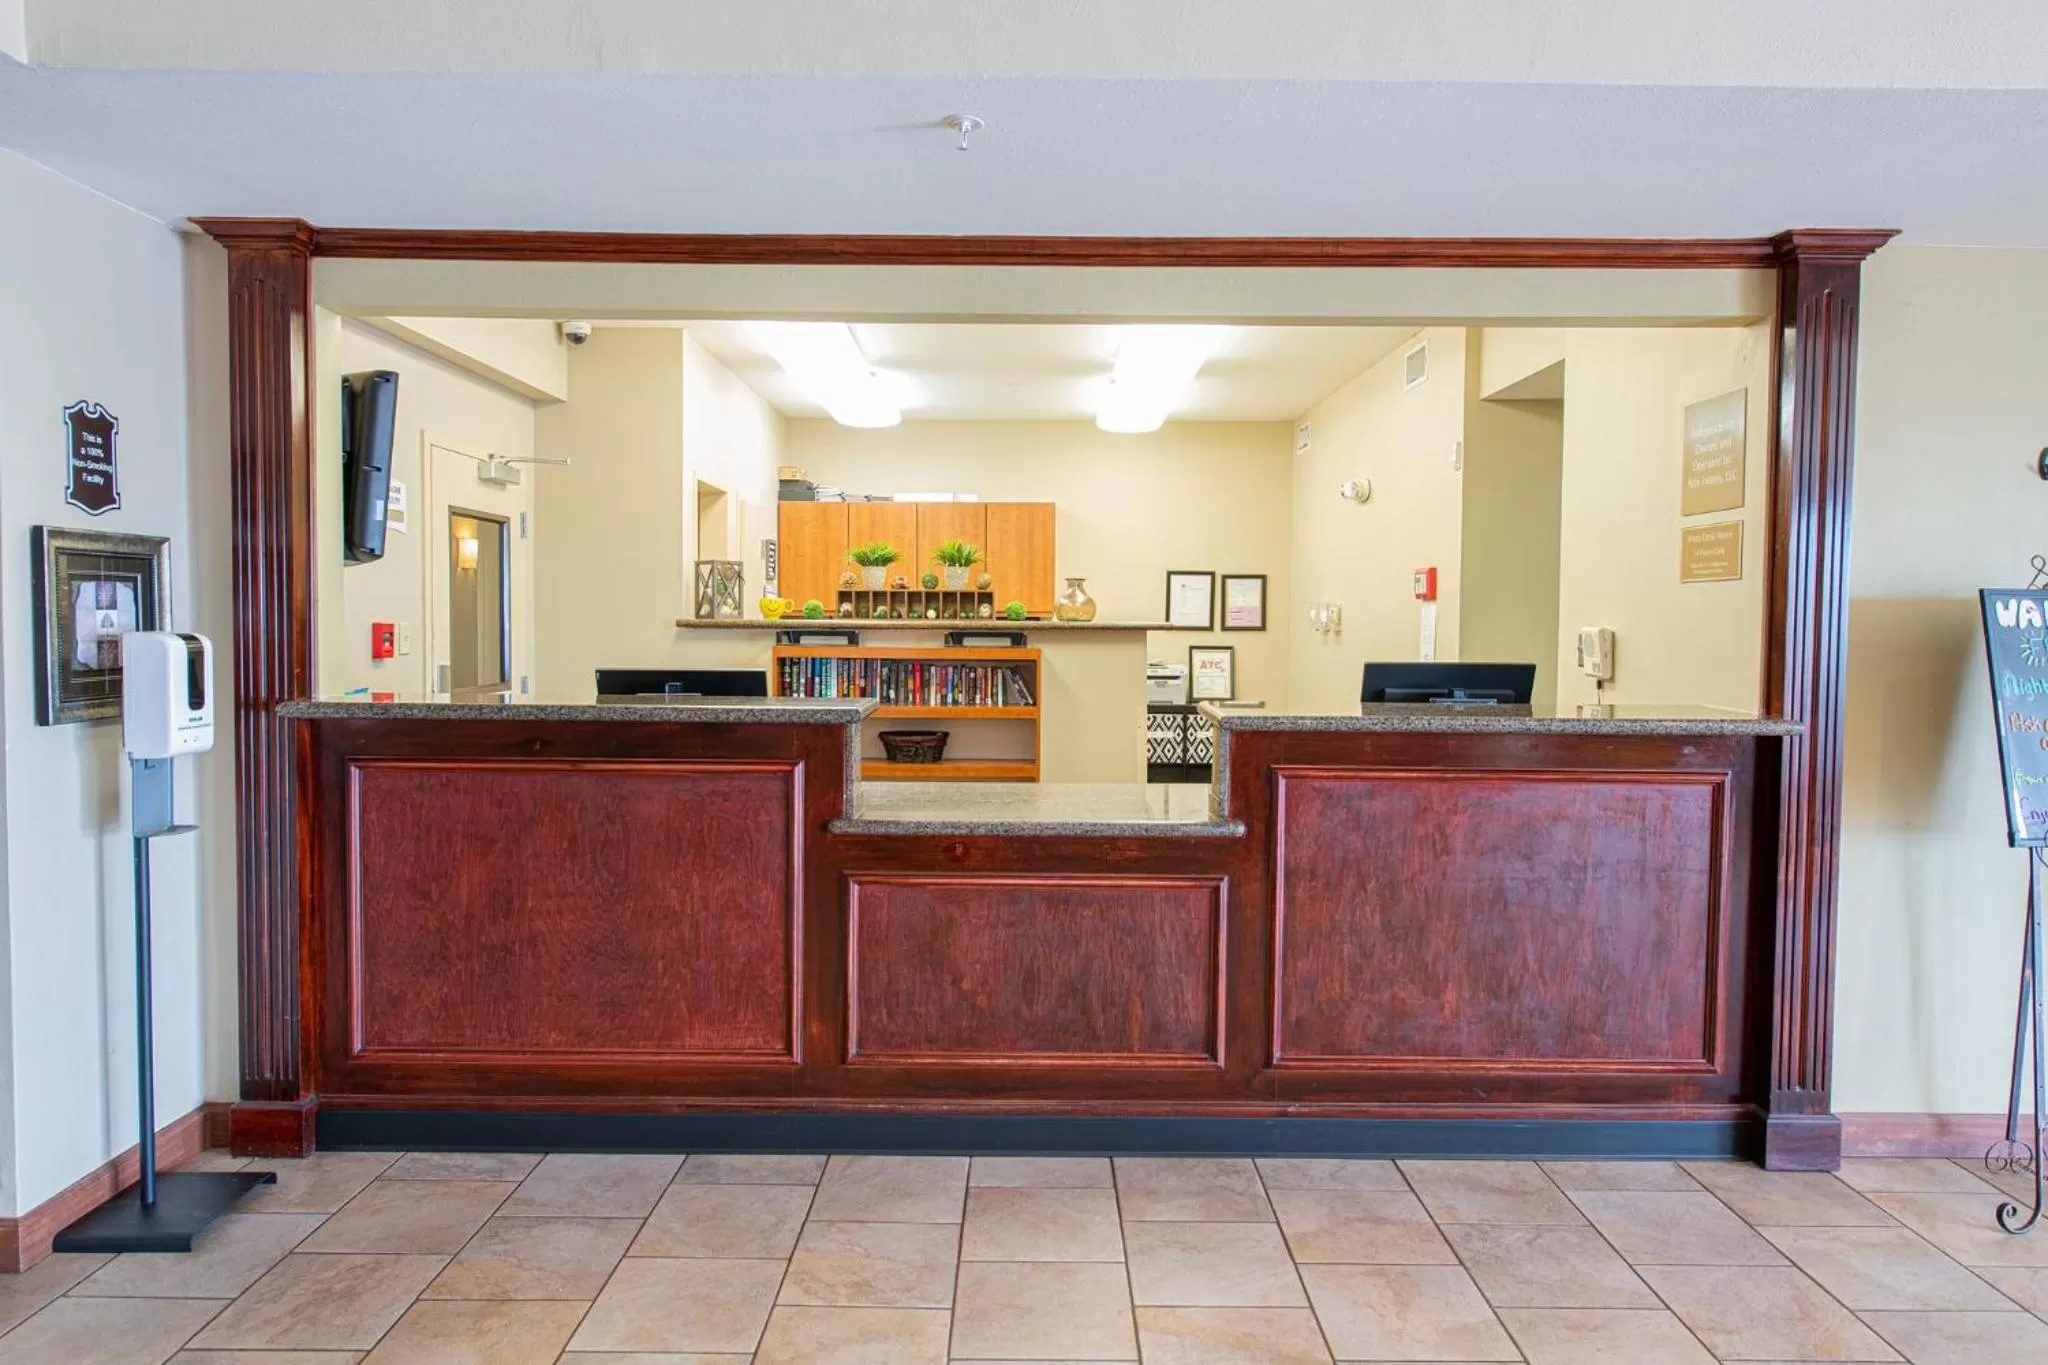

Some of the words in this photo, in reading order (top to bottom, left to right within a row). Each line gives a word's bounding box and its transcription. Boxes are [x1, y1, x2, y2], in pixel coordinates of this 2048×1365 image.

[82, 431, 95, 443] This
[82, 472, 104, 486] Facility
[1995, 599, 2048, 629] WA
